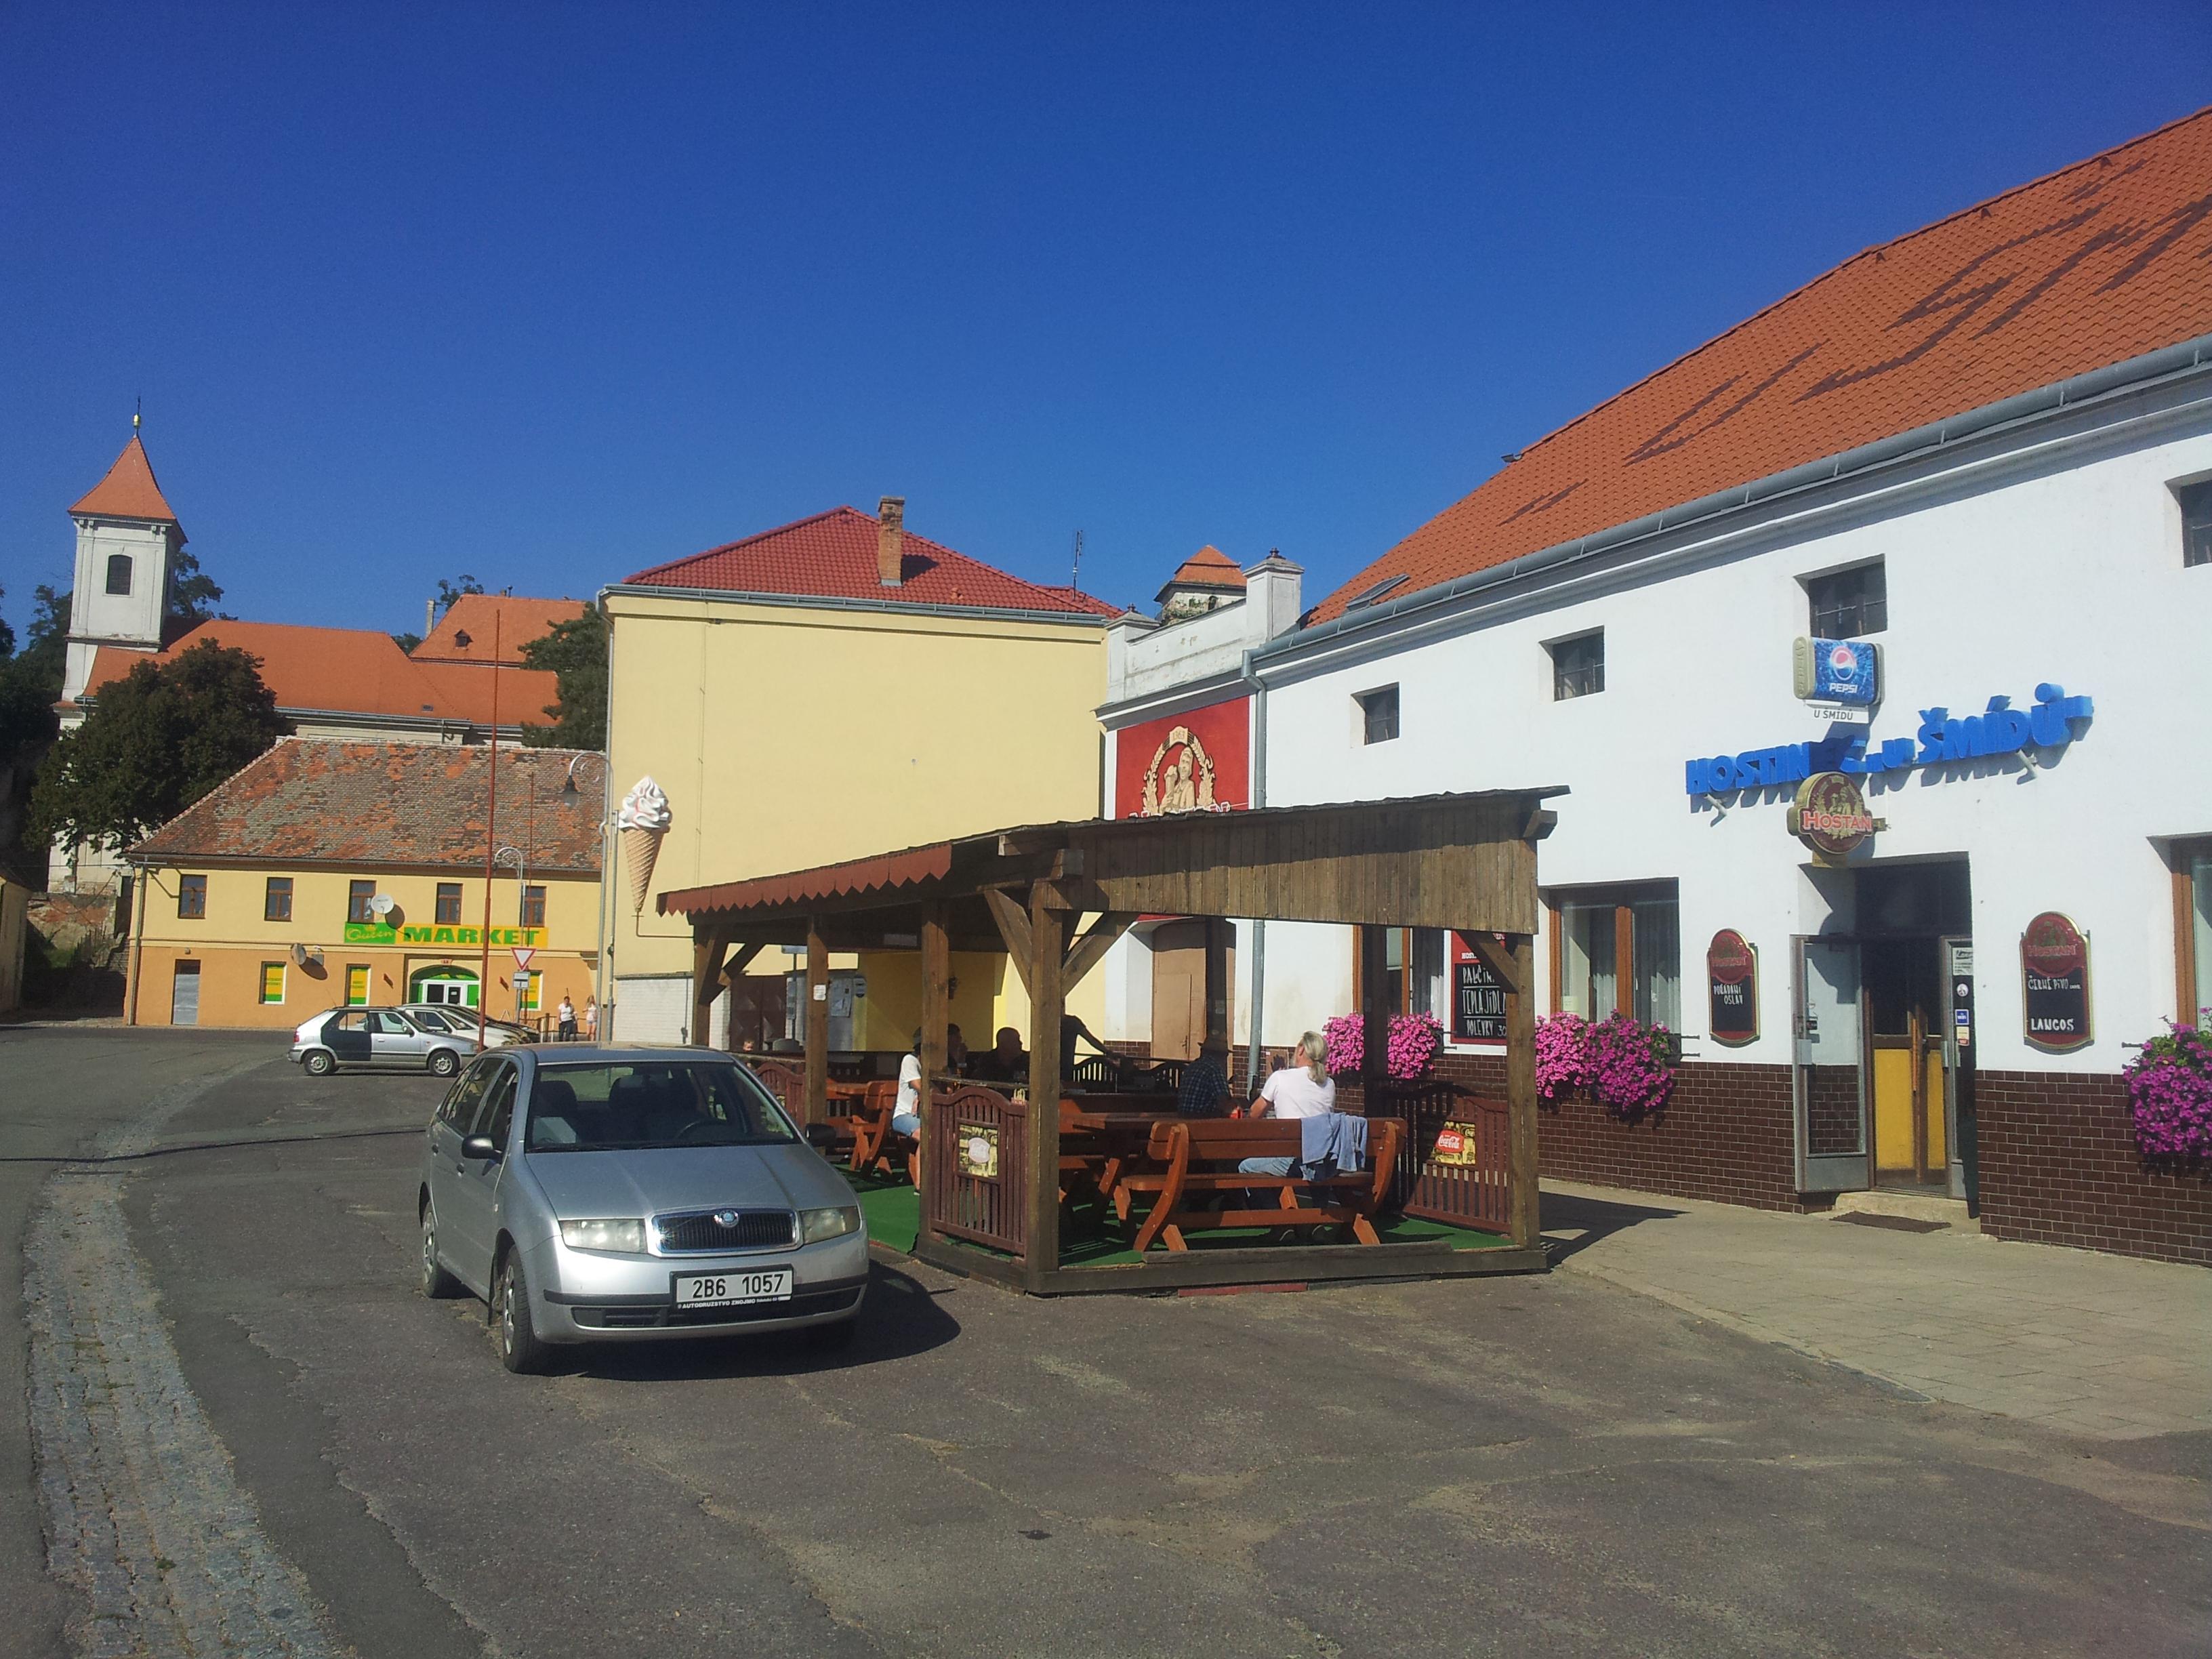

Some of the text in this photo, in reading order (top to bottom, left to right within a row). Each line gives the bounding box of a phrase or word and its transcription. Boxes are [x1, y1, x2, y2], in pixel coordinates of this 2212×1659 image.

[1829, 683, 1858, 693] PEPSI
[1814, 710, 1820, 718] U
[1802, 811, 1872, 833] HOSTAN
[346, 926, 539, 945] Queen MARKET
[1723, 995, 1743, 1004] OSLAV
[692, 1273, 785, 1299] 2B6 1057
